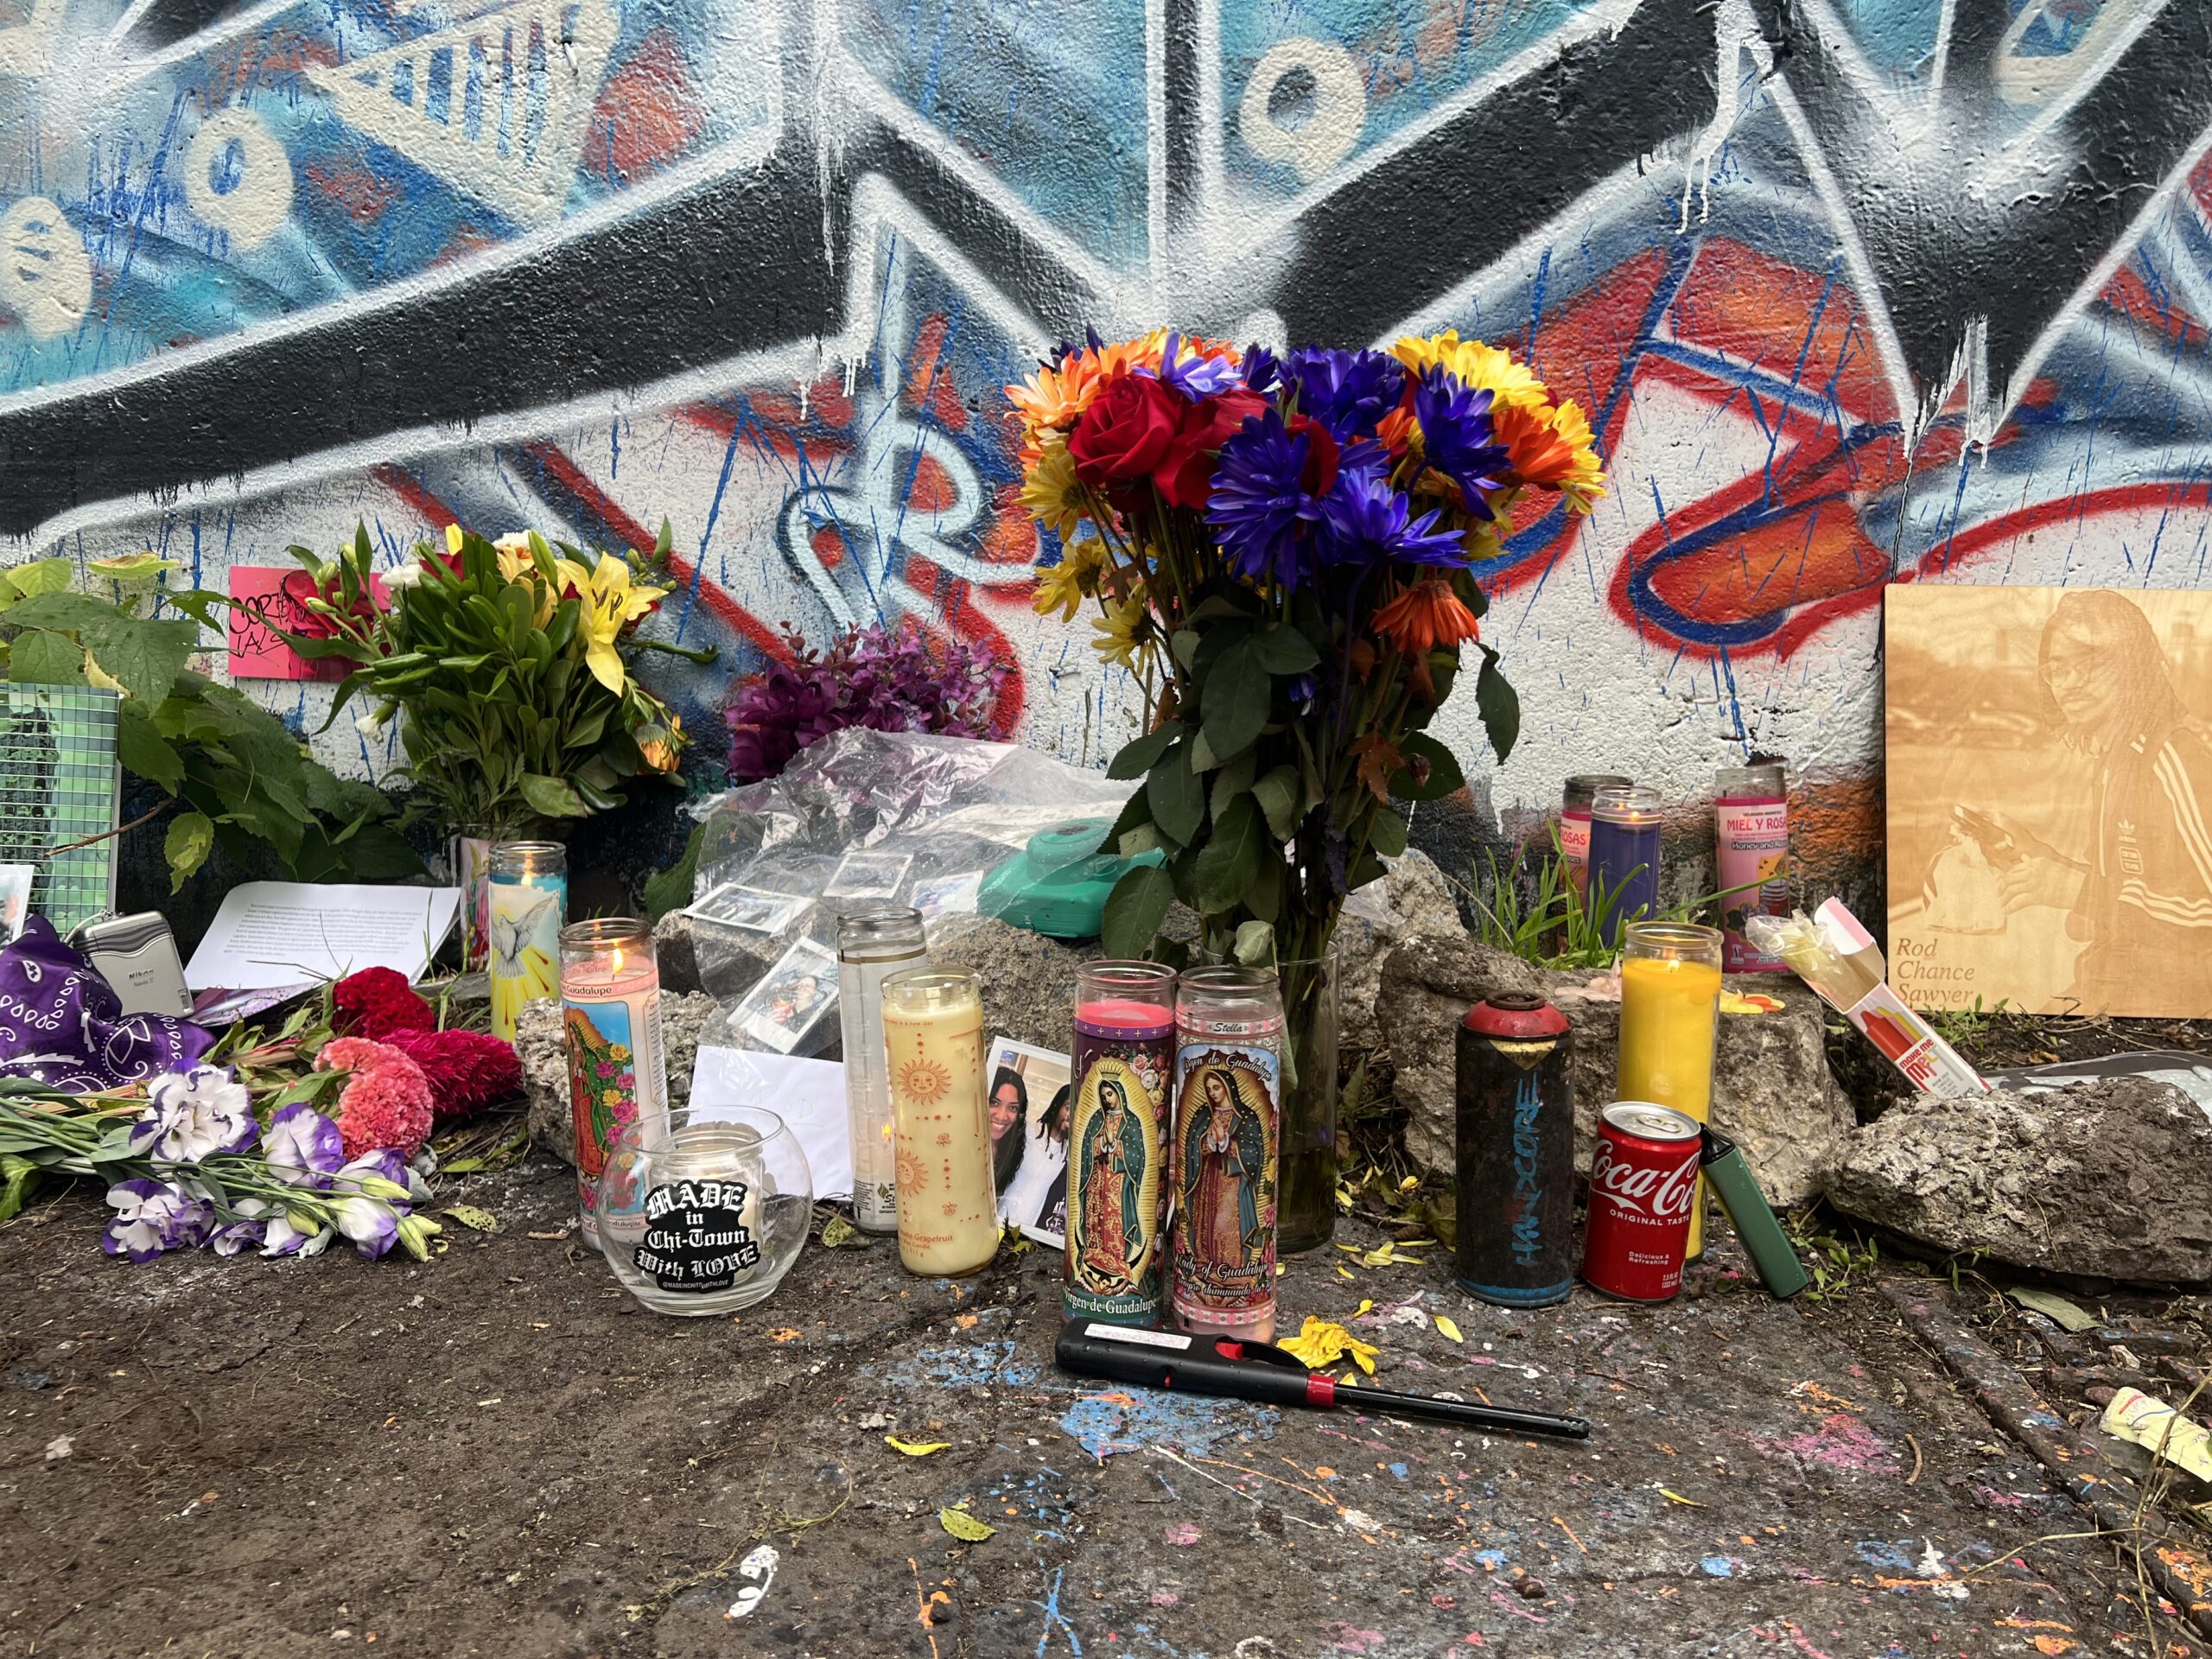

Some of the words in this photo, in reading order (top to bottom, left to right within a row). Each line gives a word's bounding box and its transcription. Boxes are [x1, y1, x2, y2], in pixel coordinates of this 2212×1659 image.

[1727, 819, 1752, 831] MIEL
[1756, 818, 1763, 830] Y
[1759, 840, 1773, 849] and
[1896, 938, 1938, 957] Rod
[129, 969, 154, 980] Nikon
[1897, 961, 1975, 981] Chance
[567, 986, 612, 996] Guadalupe
[1898, 983, 1974, 1007] Sawyer
[1213, 1022, 1243, 1033] Stella
[1208, 1052, 1220, 1065] de
[1226, 1054, 1272, 1081] Guadalupe
[647, 1183, 744, 1220] MADE
[685, 1211, 703, 1225] in
[1610, 1209, 1663, 1226] ORIGINAL
[648, 1229, 745, 1253] Chi-Town
[914, 1233, 953, 1243] Grapefruit
[638, 1249, 684, 1281] With
[690, 1244, 758, 1279] LOVE
[1629, 1251, 1663, 1260] Delicious
[1202, 1261, 1213, 1280] of
[1090, 1298, 1103, 1313] de
[1106, 1299, 1157, 1314] Guadalupe
